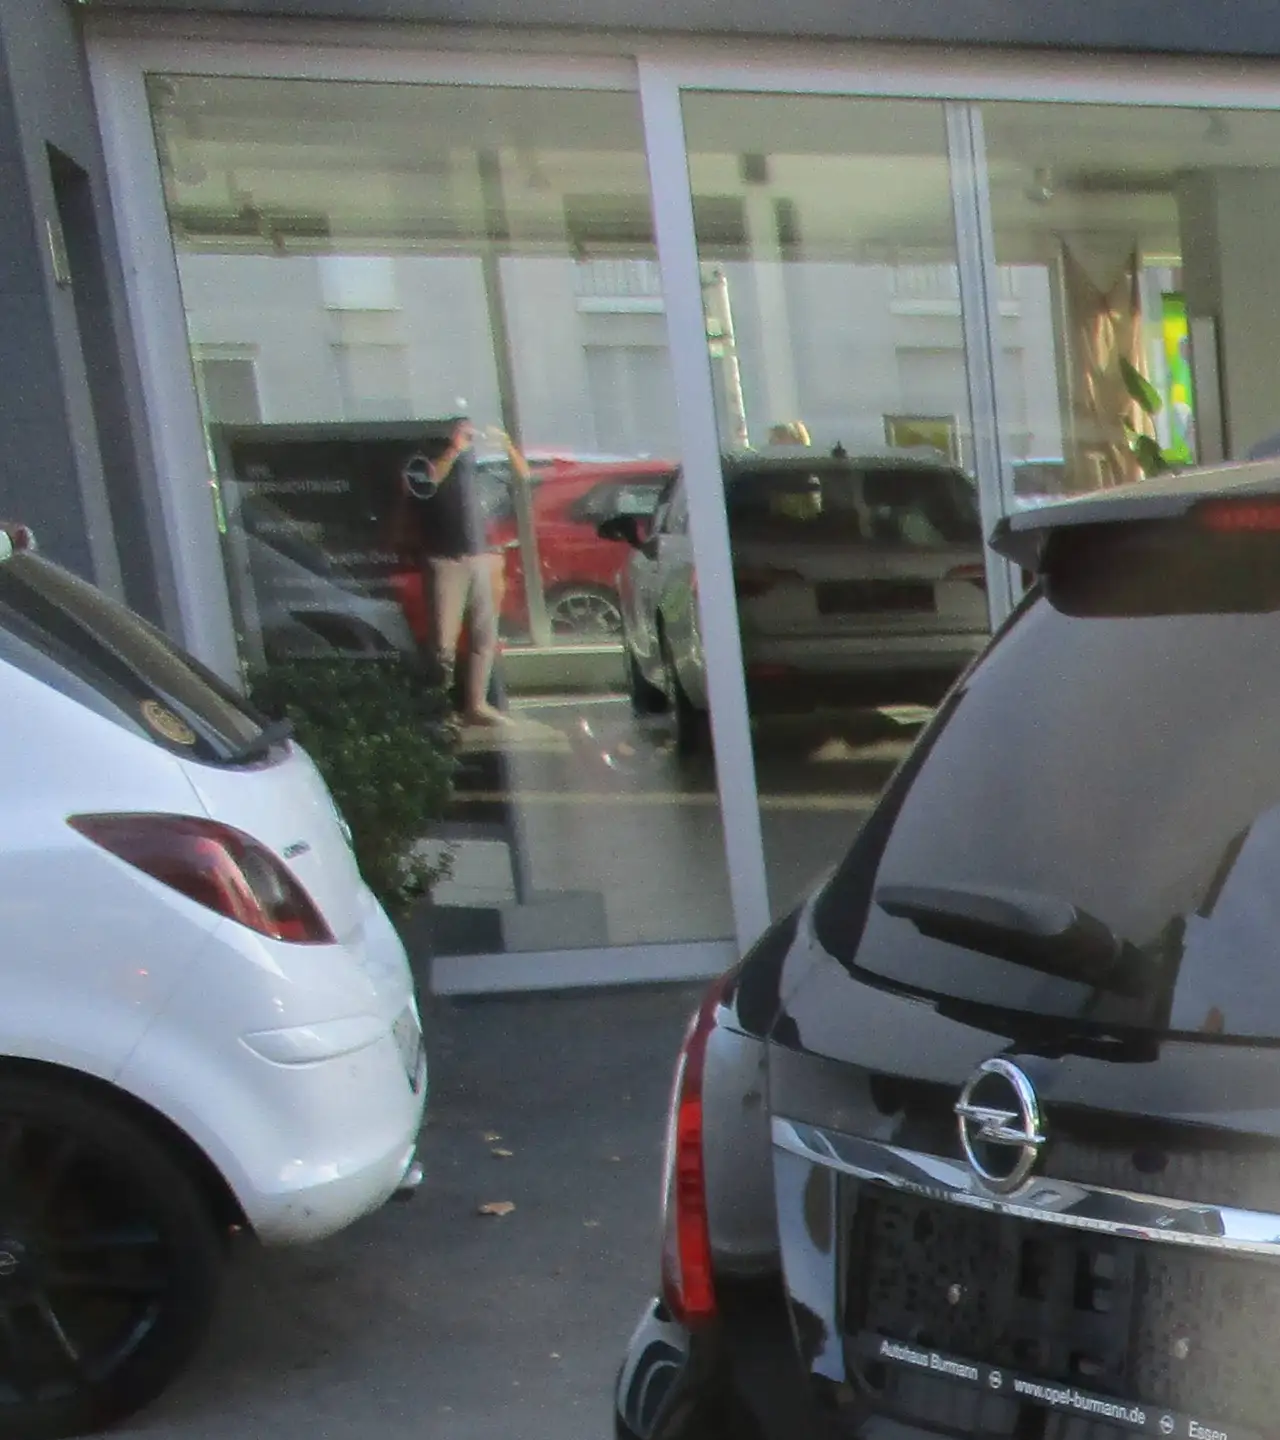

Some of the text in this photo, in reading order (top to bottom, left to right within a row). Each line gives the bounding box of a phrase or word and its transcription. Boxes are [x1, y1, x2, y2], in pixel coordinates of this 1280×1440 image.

[880, 1340, 929, 1366] Autohaus
[930, 1353, 978, 1380] Burmann
[1014, 1378, 1145, 1424] www.opel-burmann.de
